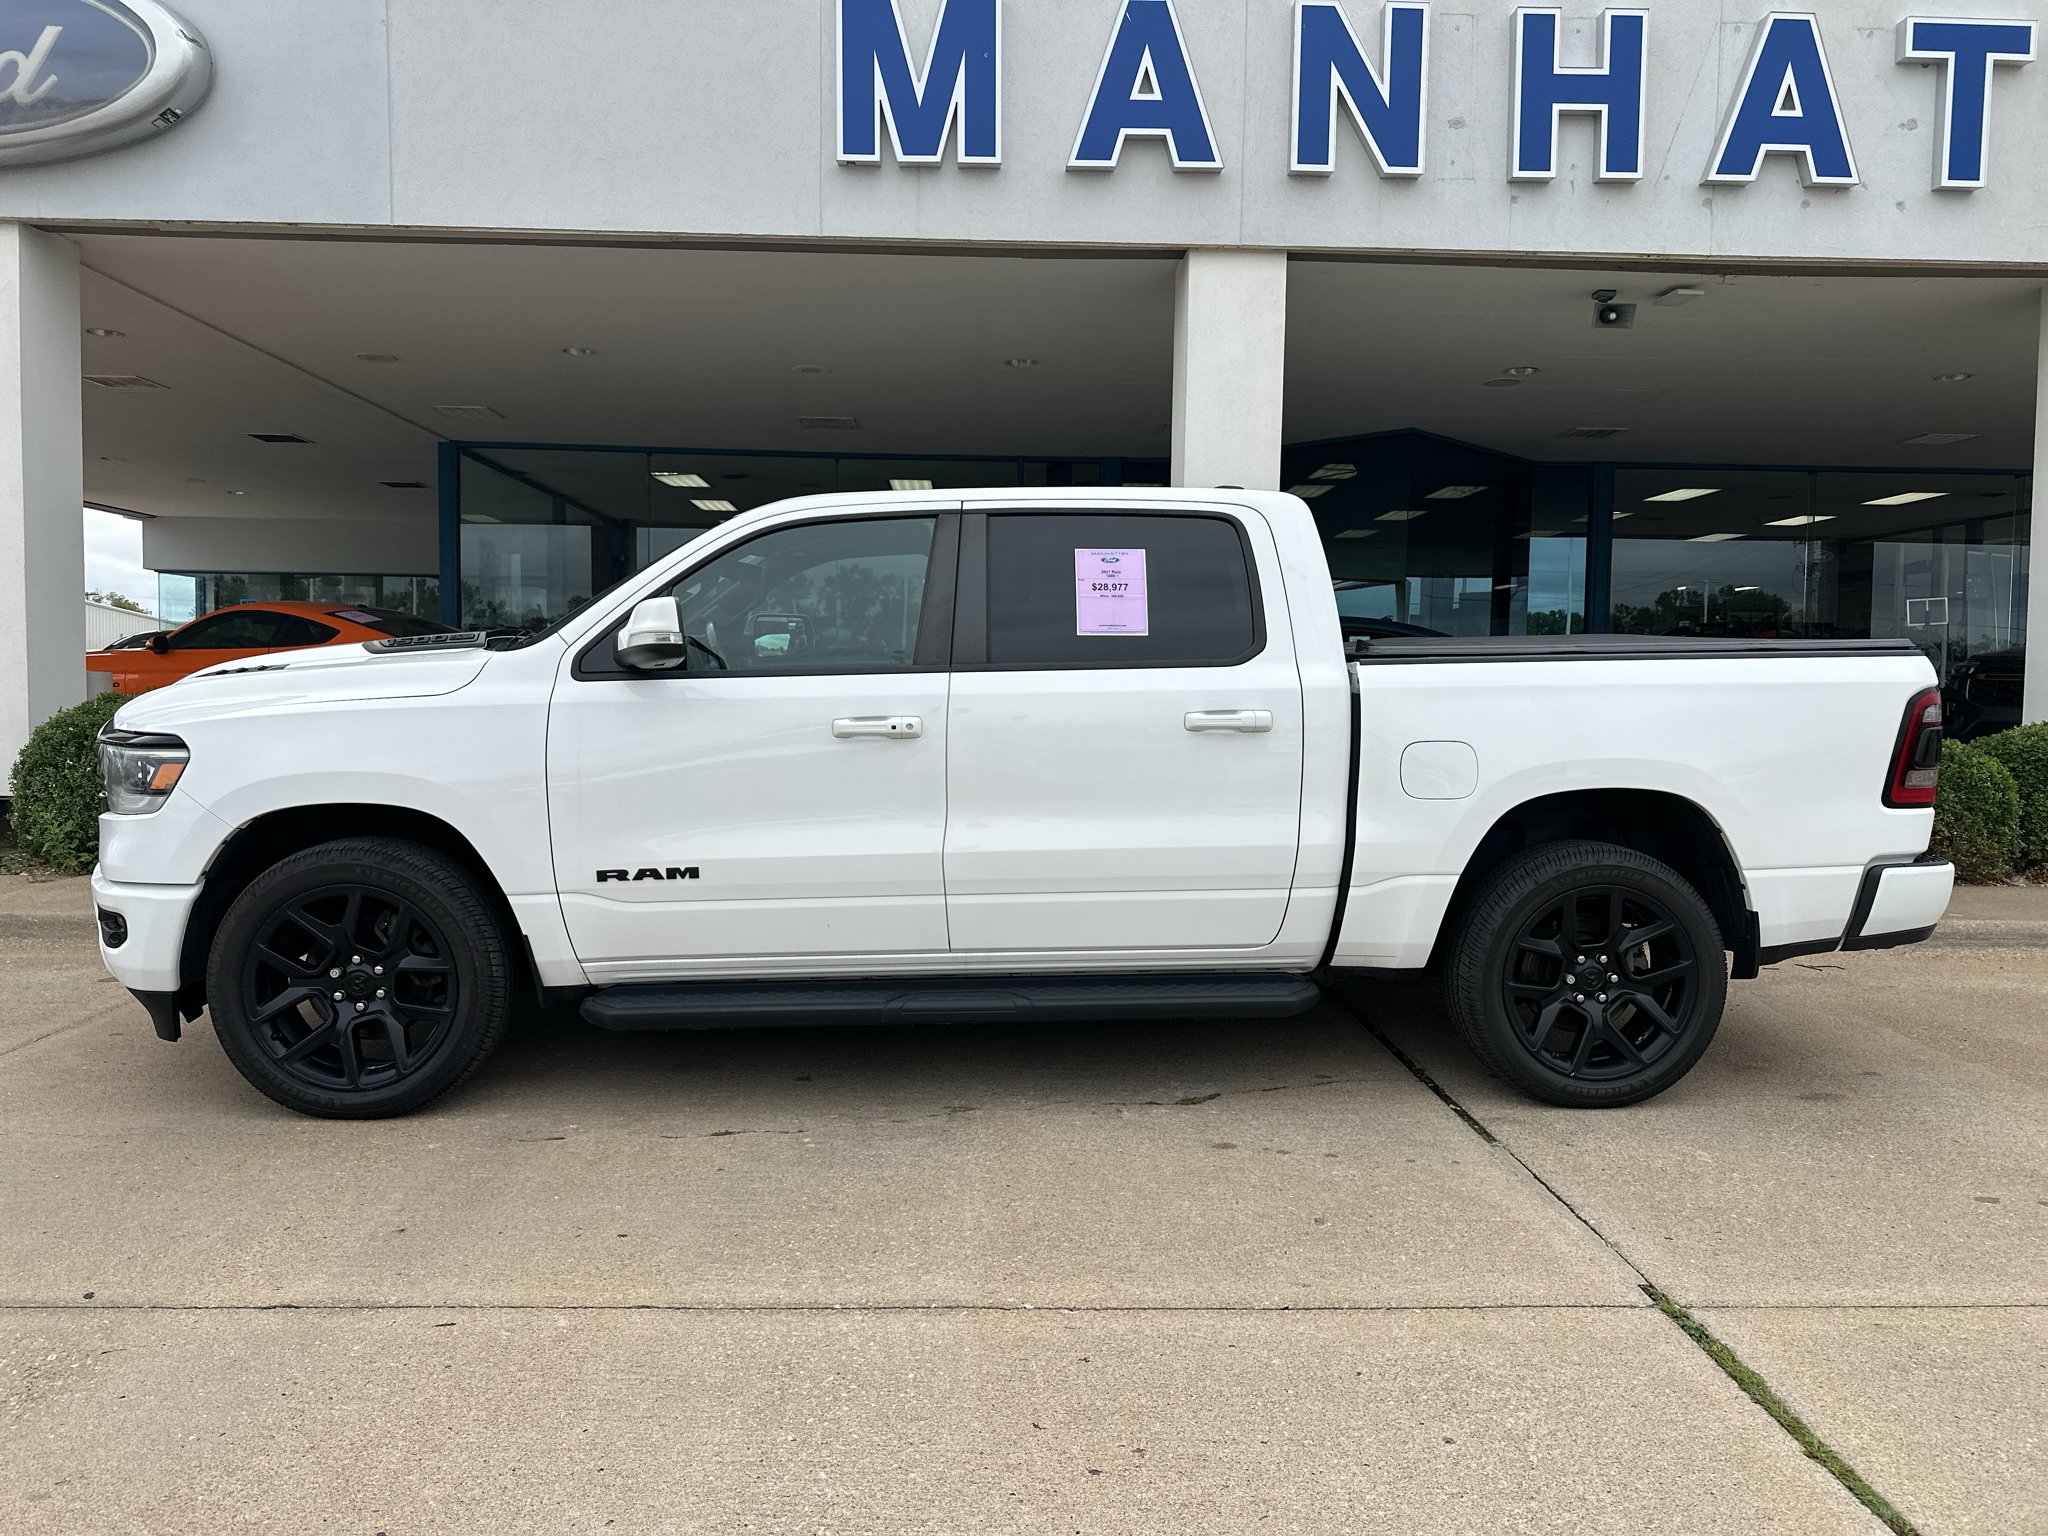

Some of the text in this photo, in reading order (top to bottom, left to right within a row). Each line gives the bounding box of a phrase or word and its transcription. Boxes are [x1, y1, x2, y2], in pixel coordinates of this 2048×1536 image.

[836, 0, 2038, 191] MANHAT
[1091, 582, 1129, 592] $28,977
[387, 634, 449, 646] 1500
[596, 867, 699, 882] RAM
[1576, 869, 1642, 880] MICHELIN
